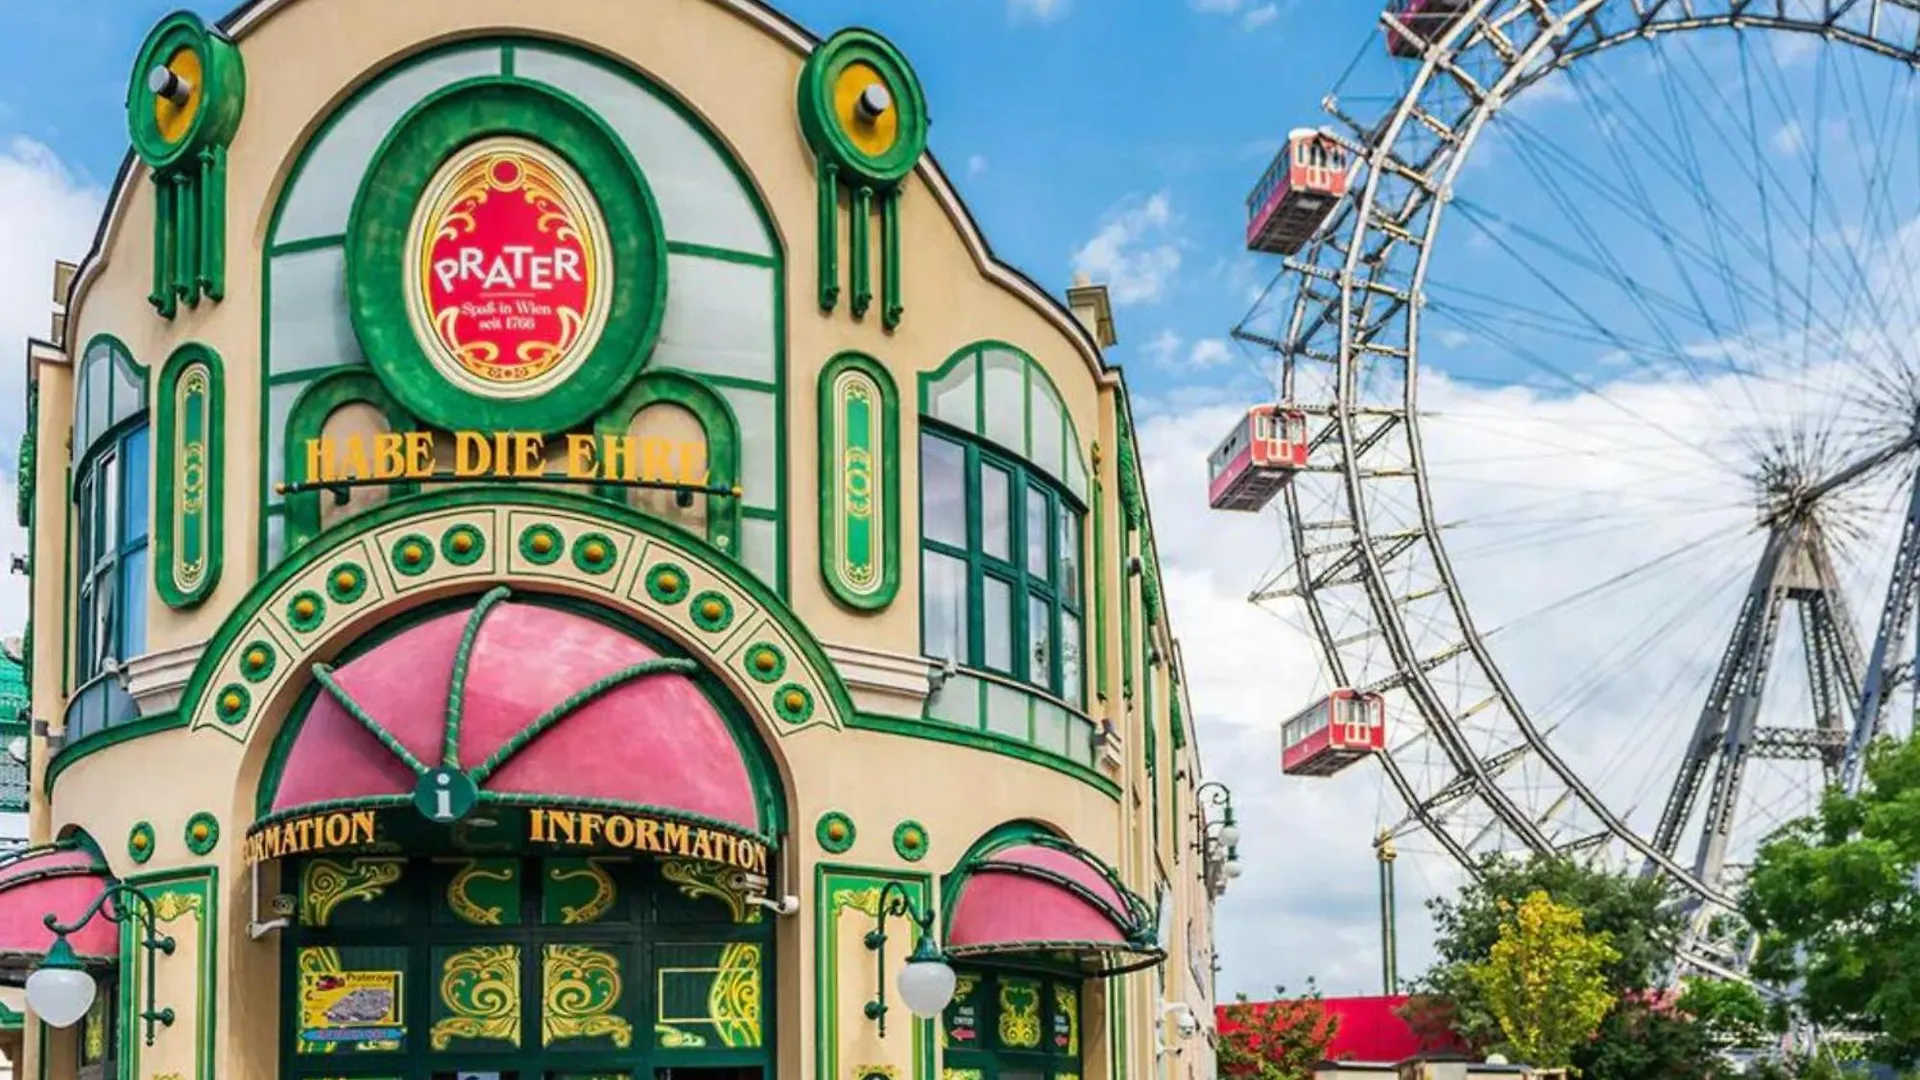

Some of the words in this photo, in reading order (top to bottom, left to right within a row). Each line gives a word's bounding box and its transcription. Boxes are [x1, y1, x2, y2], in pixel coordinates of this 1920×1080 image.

[434, 245, 582, 293] PRATER
[478, 316, 502, 331] seit
[506, 317, 536, 331] 1766
[500, 301, 512, 315] in
[515, 300, 552, 315] Wien
[305, 431, 436, 484] HABE
[454, 430, 547, 477] DIE
[566, 433, 711, 487] EHRE
[529, 808, 768, 875] INFORMATION
